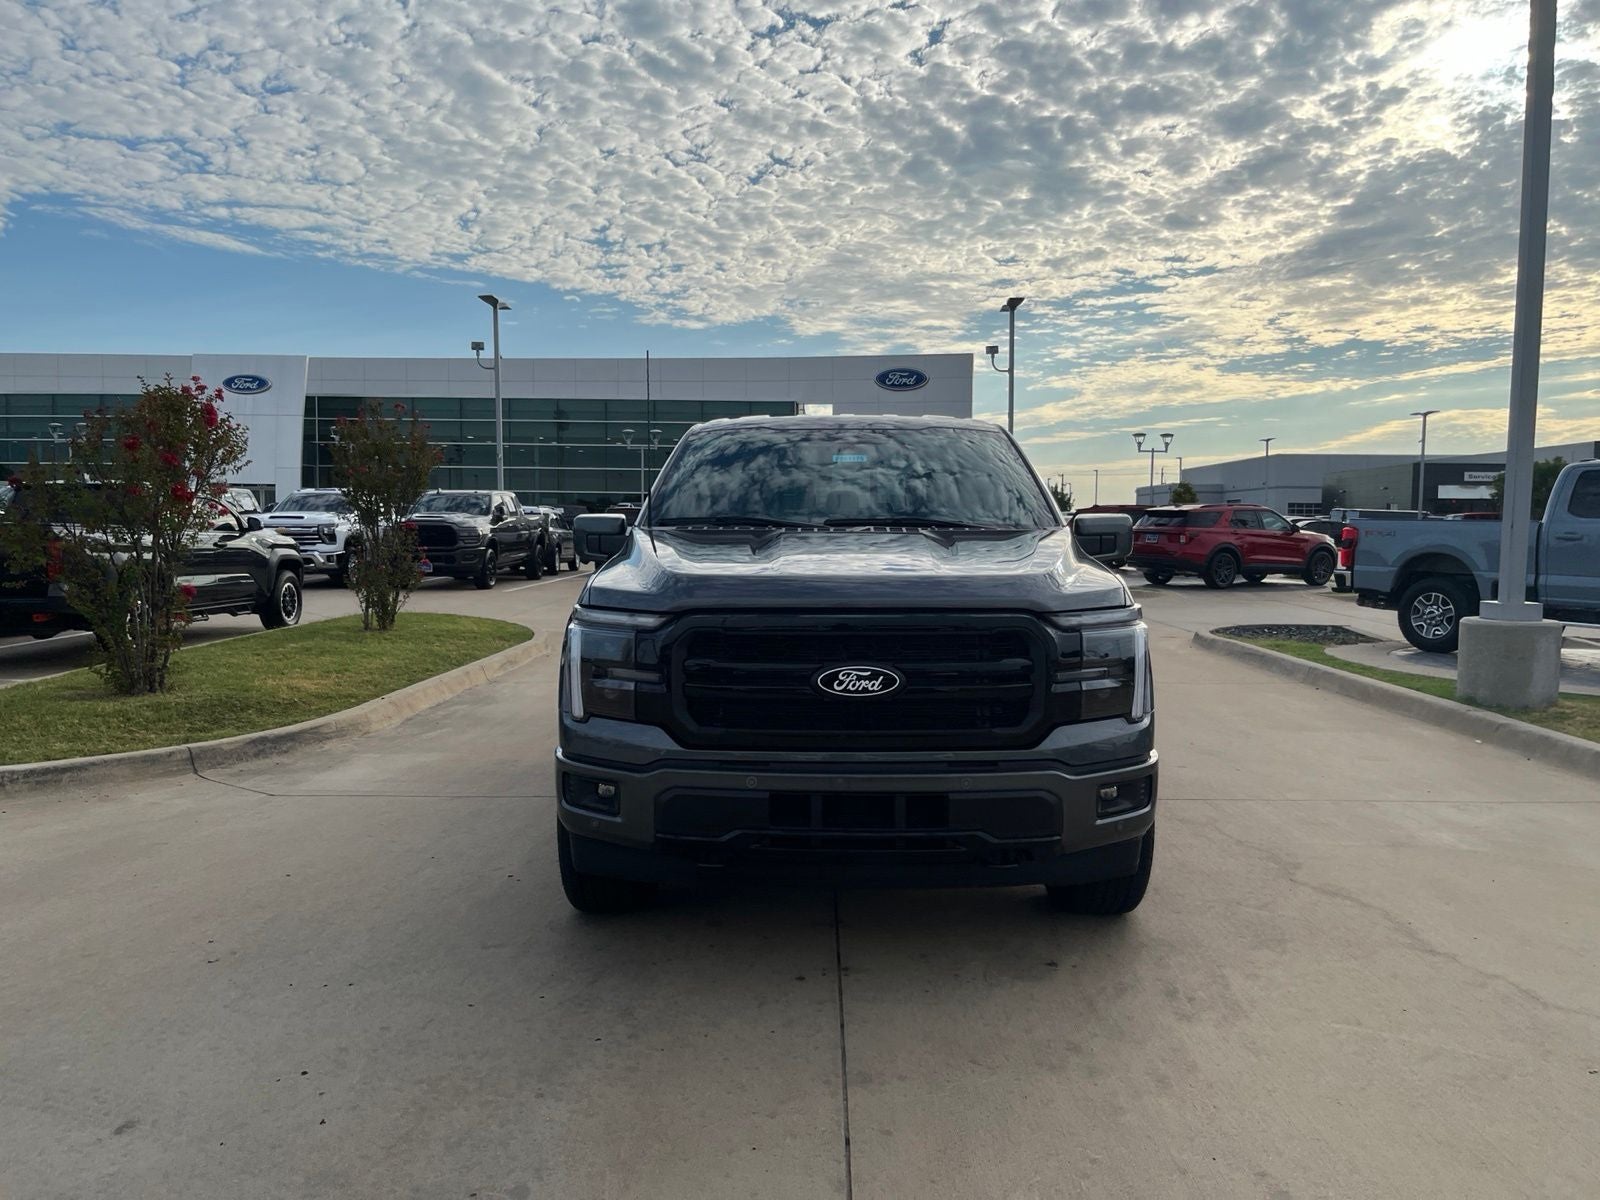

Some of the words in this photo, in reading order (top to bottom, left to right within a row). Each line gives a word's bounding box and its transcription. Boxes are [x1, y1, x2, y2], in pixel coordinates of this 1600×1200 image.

[231, 377, 259, 389] Ford
[883, 372, 917, 385] Ford
[833, 670, 884, 691] Ford
